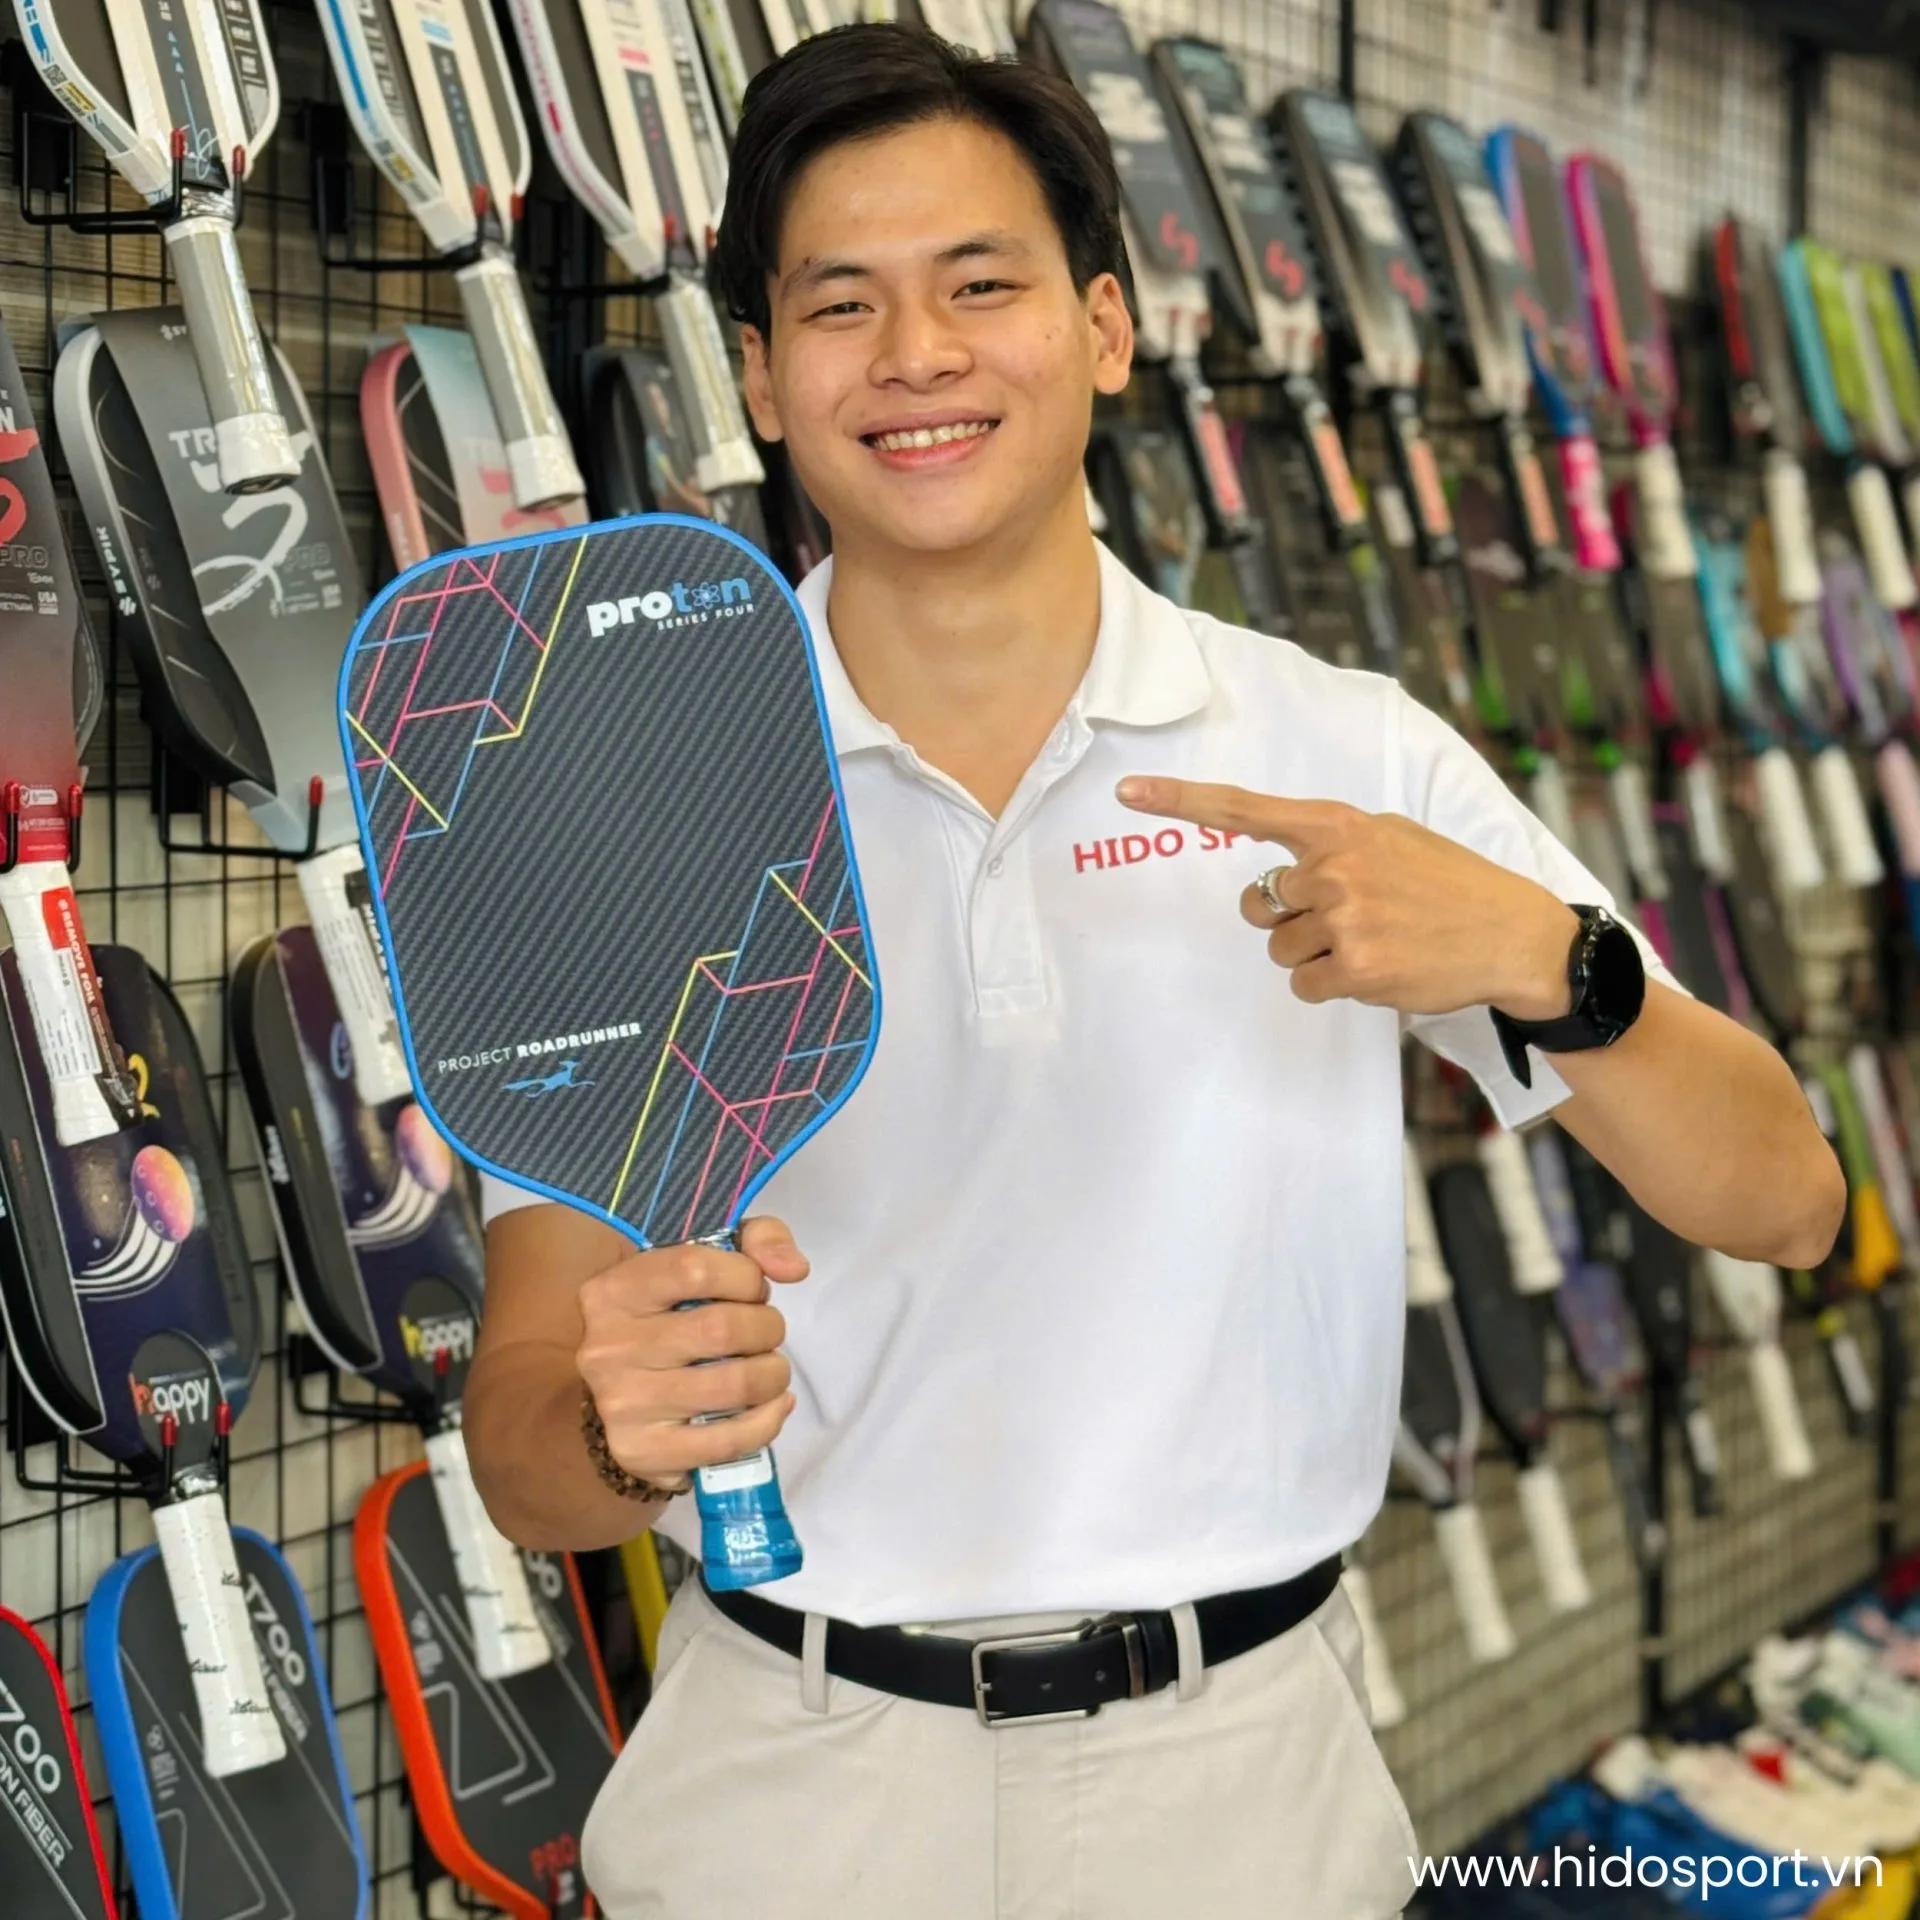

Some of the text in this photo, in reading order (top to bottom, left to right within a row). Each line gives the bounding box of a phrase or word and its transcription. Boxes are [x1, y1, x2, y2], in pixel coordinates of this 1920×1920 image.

[657, 603, 755, 631] SERIES FOUR
[1073, 828, 1184, 874] HIDO
[61, 909, 86, 971] REMOVE
[80, 972, 96, 1007] FOIL
[437, 1022, 642, 1074] PROJECT ROADRUNNER
[128, 1372, 210, 1428] happy
[0, 1679, 61, 1794] 700
[15, 1788, 65, 1868] FIBER
